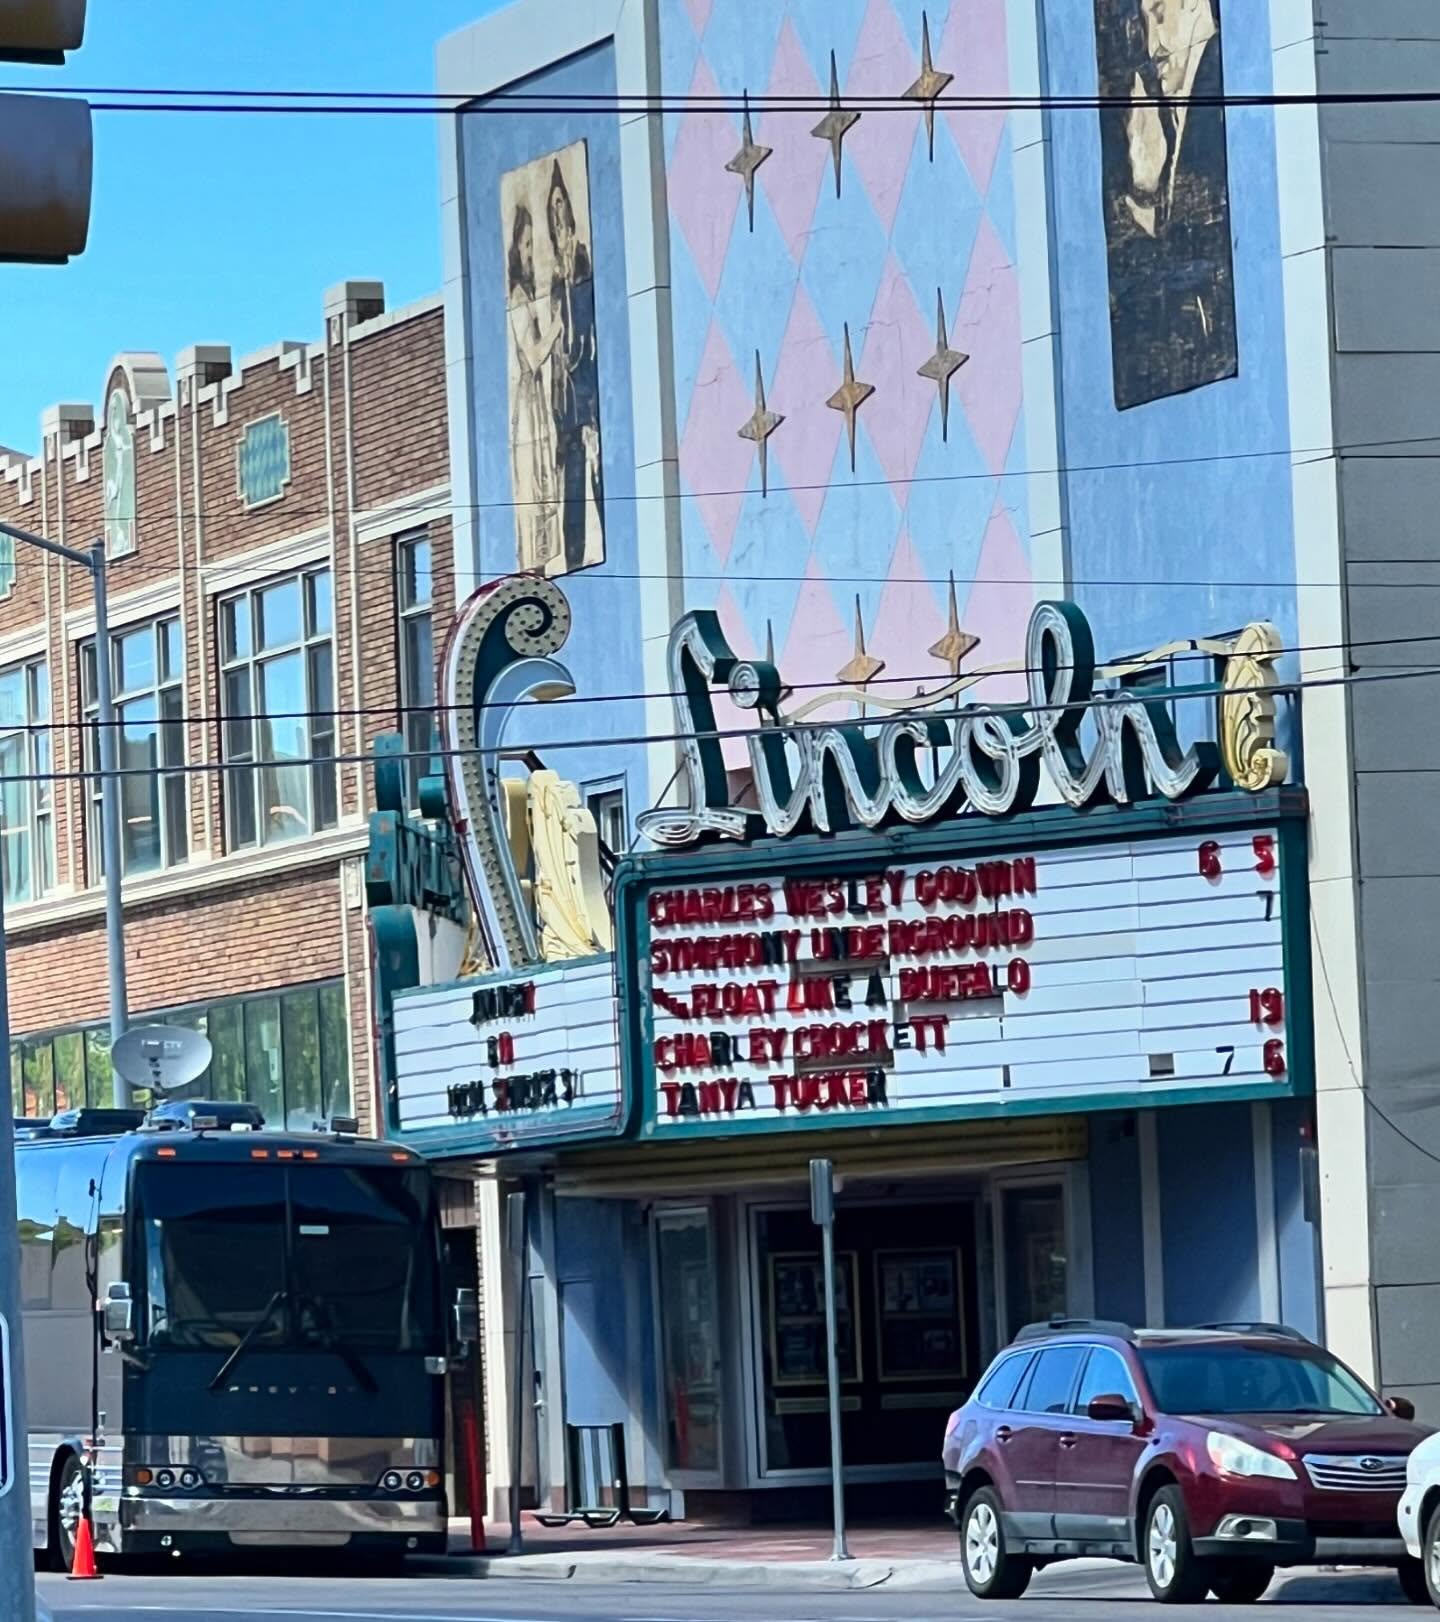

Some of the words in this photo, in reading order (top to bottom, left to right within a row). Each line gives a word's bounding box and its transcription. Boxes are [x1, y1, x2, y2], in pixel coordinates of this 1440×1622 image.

[634, 599, 1219, 847] Lincoln
[1198, 840, 1222, 878] 6
[1252, 834, 1275, 873] 5
[648, 884, 775, 927] CHARLES
[783, 869, 907, 917] WESLEY
[915, 857, 1037, 907] GODWIN
[1256, 890, 1274, 921] 7
[650, 927, 801, 974] SYMPHONY
[811, 908, 1035, 960] UNDERGROUND
[691, 979, 779, 1019] FLOAT
[788, 973, 853, 1015] LIKE
[864, 972, 889, 1008] A
[899, 957, 1031, 1001] BUFFALO
[1248, 987, 1283, 1025] 19
[654, 1027, 787, 1072] CHARLEY
[792, 1014, 950, 1061] CROCKETT
[1215, 1045, 1235, 1075] 7
[1262, 1037, 1285, 1077] 6
[660, 1076, 756, 1116] TANYA
[768, 1068, 889, 1112] TUCKER
